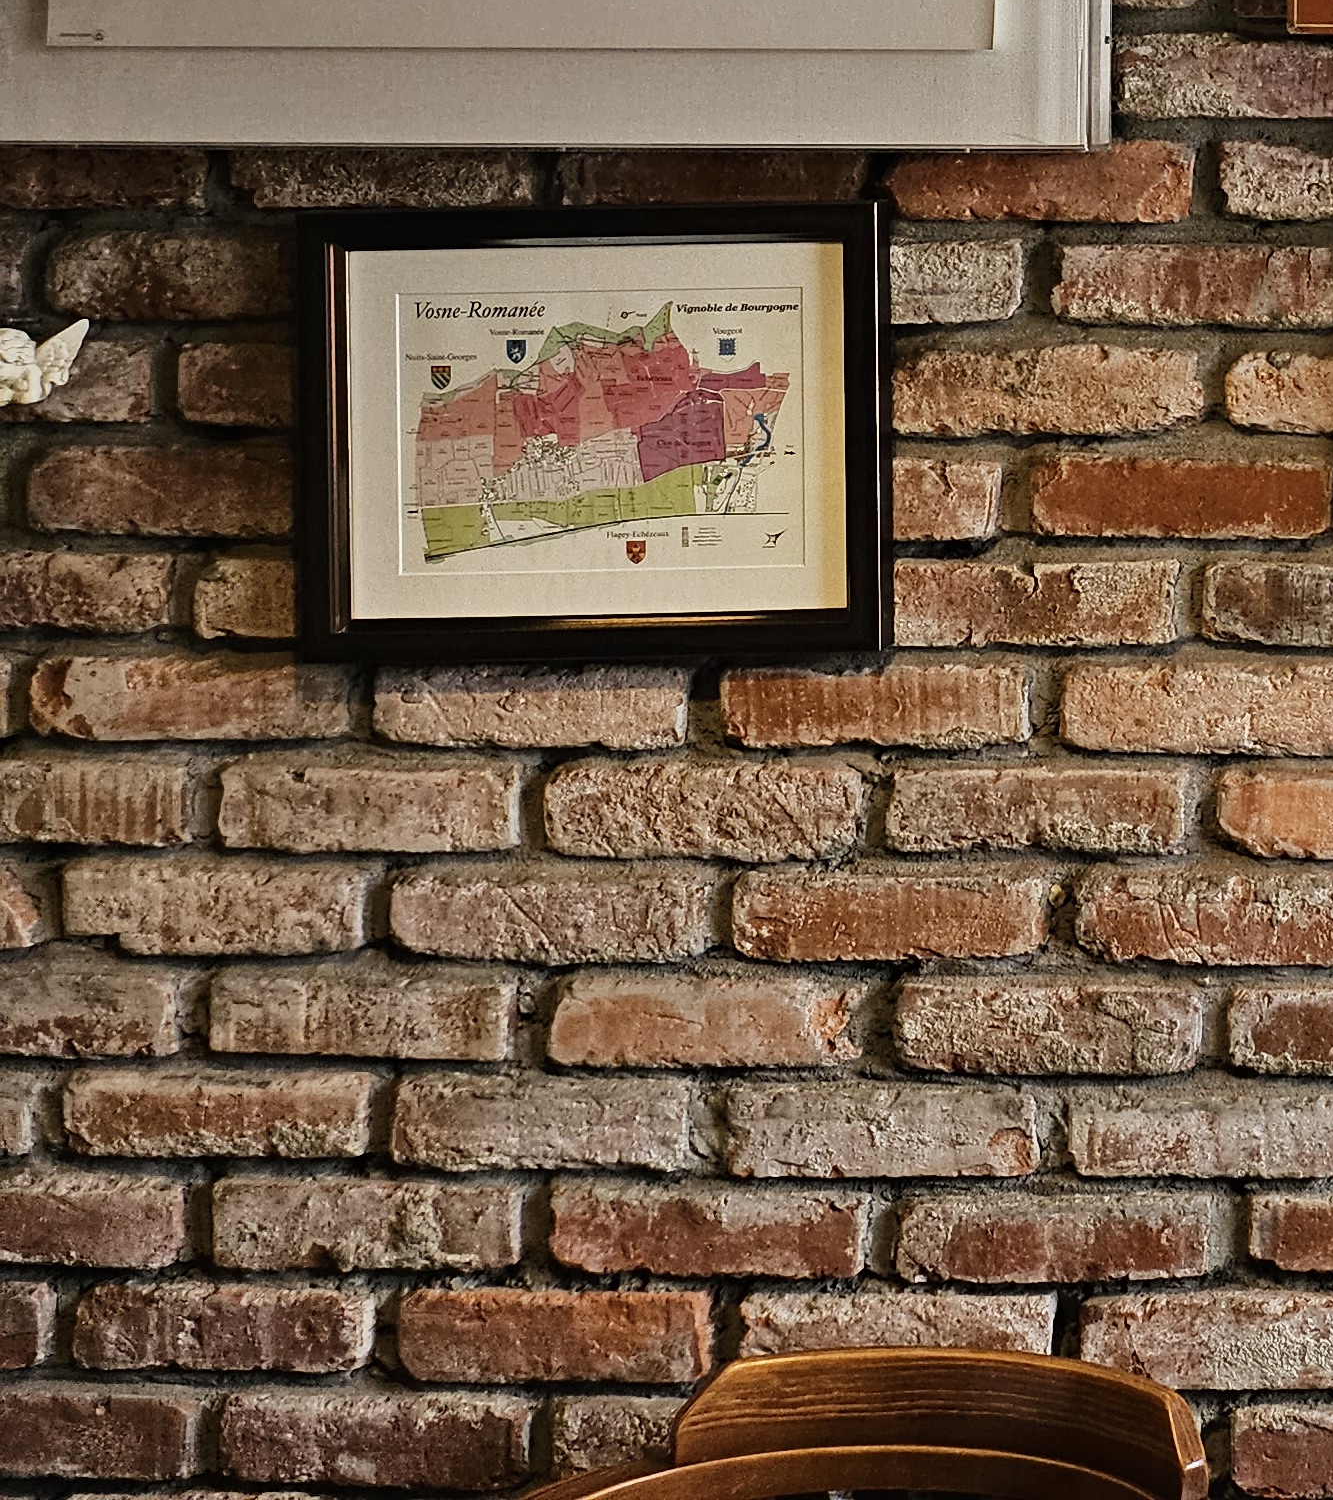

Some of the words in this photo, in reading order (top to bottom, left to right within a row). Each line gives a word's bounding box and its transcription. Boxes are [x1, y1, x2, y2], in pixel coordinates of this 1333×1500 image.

[414, 301, 546, 319] Vosne-Romanée
[676, 304, 723, 314] Vignoble
[725, 304, 738, 312] de
[740, 303, 799, 313] Bourgogne
